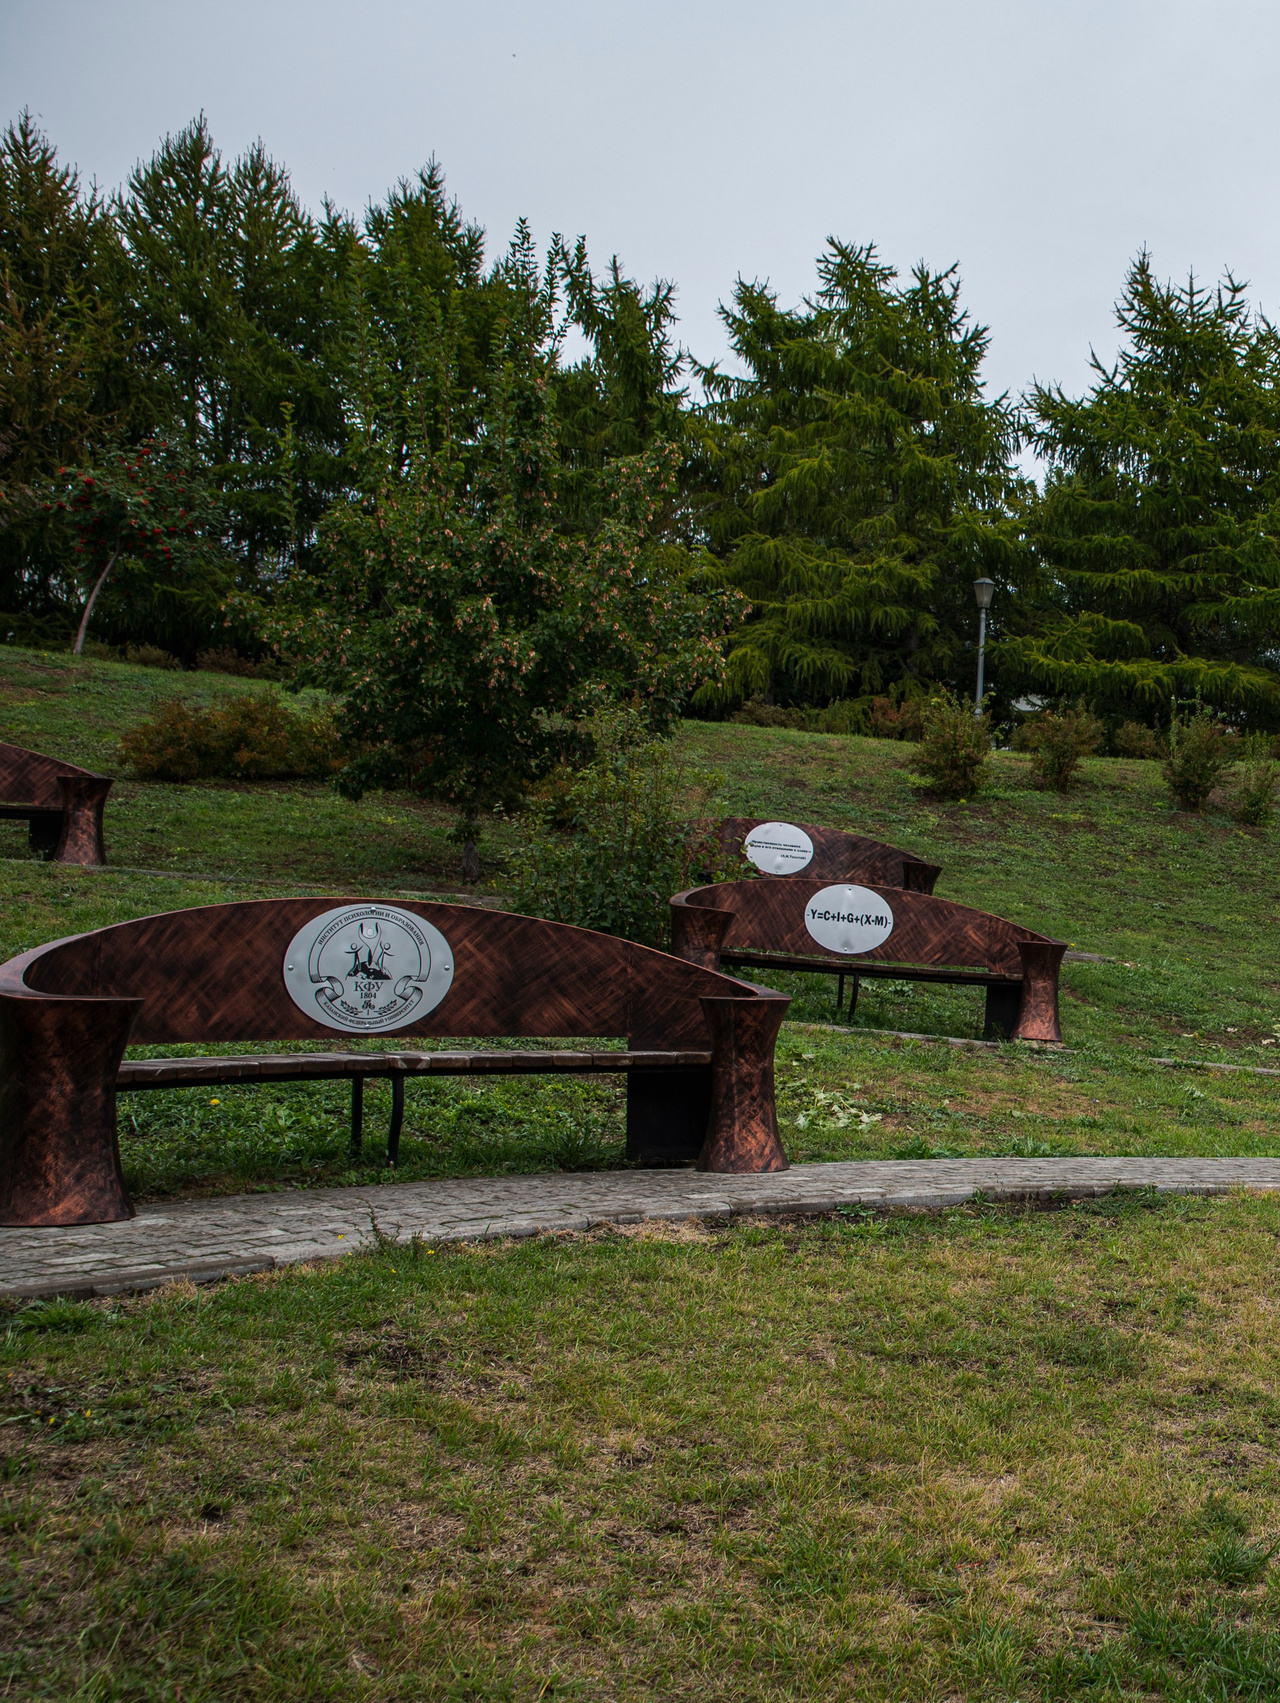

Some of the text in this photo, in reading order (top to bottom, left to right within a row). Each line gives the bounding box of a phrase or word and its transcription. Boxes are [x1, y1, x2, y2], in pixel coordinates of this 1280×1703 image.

[318, 920, 344, 946] ИНСТИТУТ
[344, 910, 384, 922] ПСИХОЛОГИИ
[390, 914, 424, 946] ОБРАЗОВАНИЯ
[354, 982, 384, 992] КФУ
[324, 1001, 348, 1022] КАЗАНСКИЙ
[385, 1000, 415, 1022] УНИВЕРСИТЕТ
